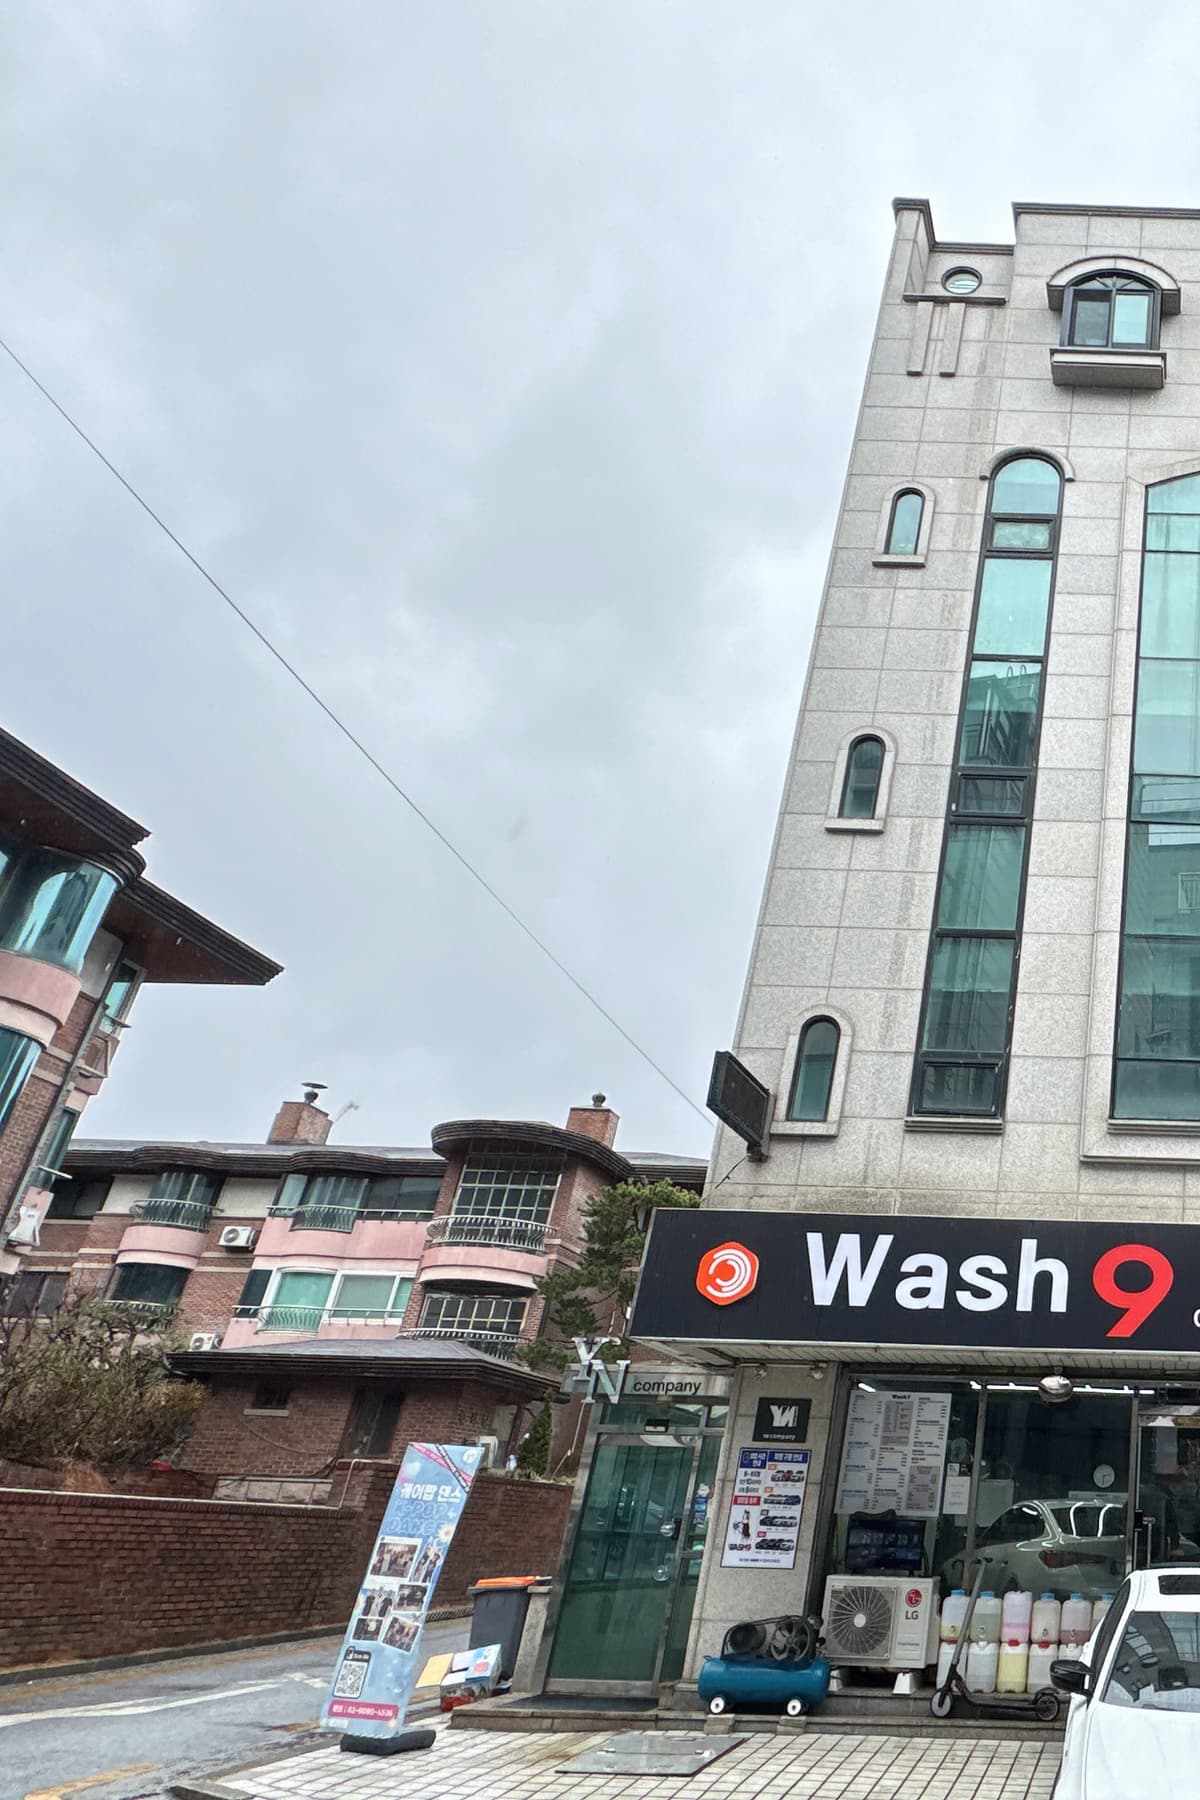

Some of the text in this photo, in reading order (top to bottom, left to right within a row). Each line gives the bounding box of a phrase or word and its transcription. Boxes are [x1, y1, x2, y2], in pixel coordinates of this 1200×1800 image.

[806, 1231, 1174, 1338] Wash 9
[633, 1381, 701, 1395] company
[400, 1482, 437, 1500] 케이팝
[905, 1610, 919, 1620] LG
